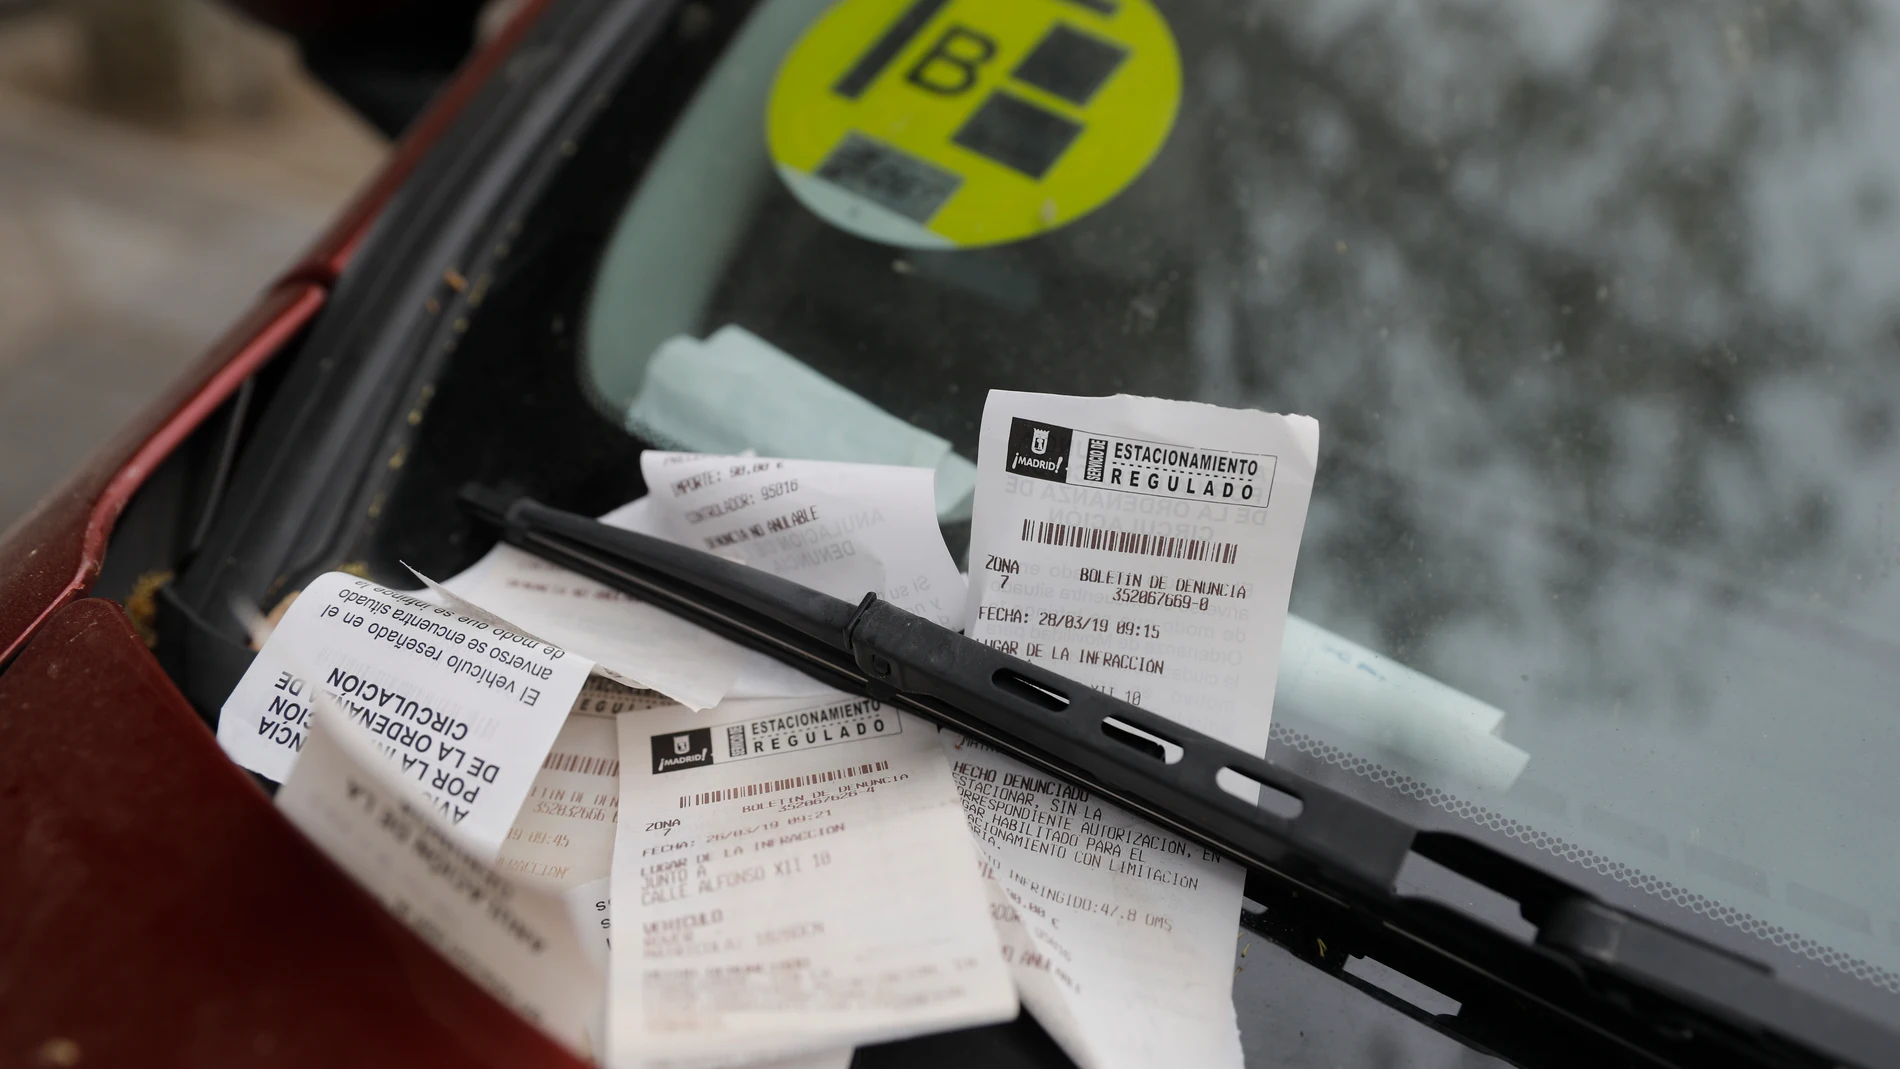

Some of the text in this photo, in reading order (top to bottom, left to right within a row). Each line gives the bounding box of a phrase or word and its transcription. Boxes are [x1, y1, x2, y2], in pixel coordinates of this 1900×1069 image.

[905, 22, 999, 96] B
[1011, 453, 1064, 475] ¡MADRID!
[1114, 441, 1259, 477] ESTACIONAMIENTO
[760, 479, 800, 502] 95016
[1111, 467, 1255, 501] REGULADO
[766, 504, 820, 534] ANULABLE
[985, 554, 1020, 575] ZONA
[1000, 575, 1010, 589] 7
[1150, 576, 1168, 591] DE
[1176, 577, 1247, 600] DENUNCIA
[433, 605, 456, 618] se
[1112, 587, 1210, 612] 352067669-0
[337, 587, 554, 681] anverso se encuentra situado
[457, 613, 490, 631] que
[978, 605, 1161, 640] FECHA: 28/03/19 09:15
[492, 627, 540, 650] modo
[542, 645, 567, 661] de
[320, 603, 542, 707] El vehículo reseñado en el
[976, 638, 1165, 675] UGAR DE LA INFRACCIÓN
[326, 666, 470, 742] CIRCULACIÓN
[1125, 690, 1142, 707] 10
[751, 699, 882, 736] ESTACIONAMIENTO
[257, 715, 309, 753] NCIA
[753, 718, 885, 753] REGULADO
[438, 740, 467, 769] LA
[658, 747, 708, 771] ¡MADRID!
[466, 756, 501, 785] DE
[953, 760, 1091, 803] HECHO DENUNCIADO
[431, 768, 481, 805] POR
[812, 789, 829, 799] DE
[838, 773, 909, 794] DENUNCIA
[645, 818, 681, 832] ZONA
[957, 785, 1221, 864] ORRESPONDIENTE AUTORIZACIÓN, EN
[1050, 800, 1079, 818] SIN
[1084, 807, 1103, 821] LA
[962, 798, 1147, 864] GAR HABILITADO PARA EL
[642, 840, 696, 858] FECHA:
[696, 850, 714, 865] DE
[724, 846, 744, 860] LA
[966, 812, 1199, 891] ACIONAMIENTO CON LIMITACIÓN
